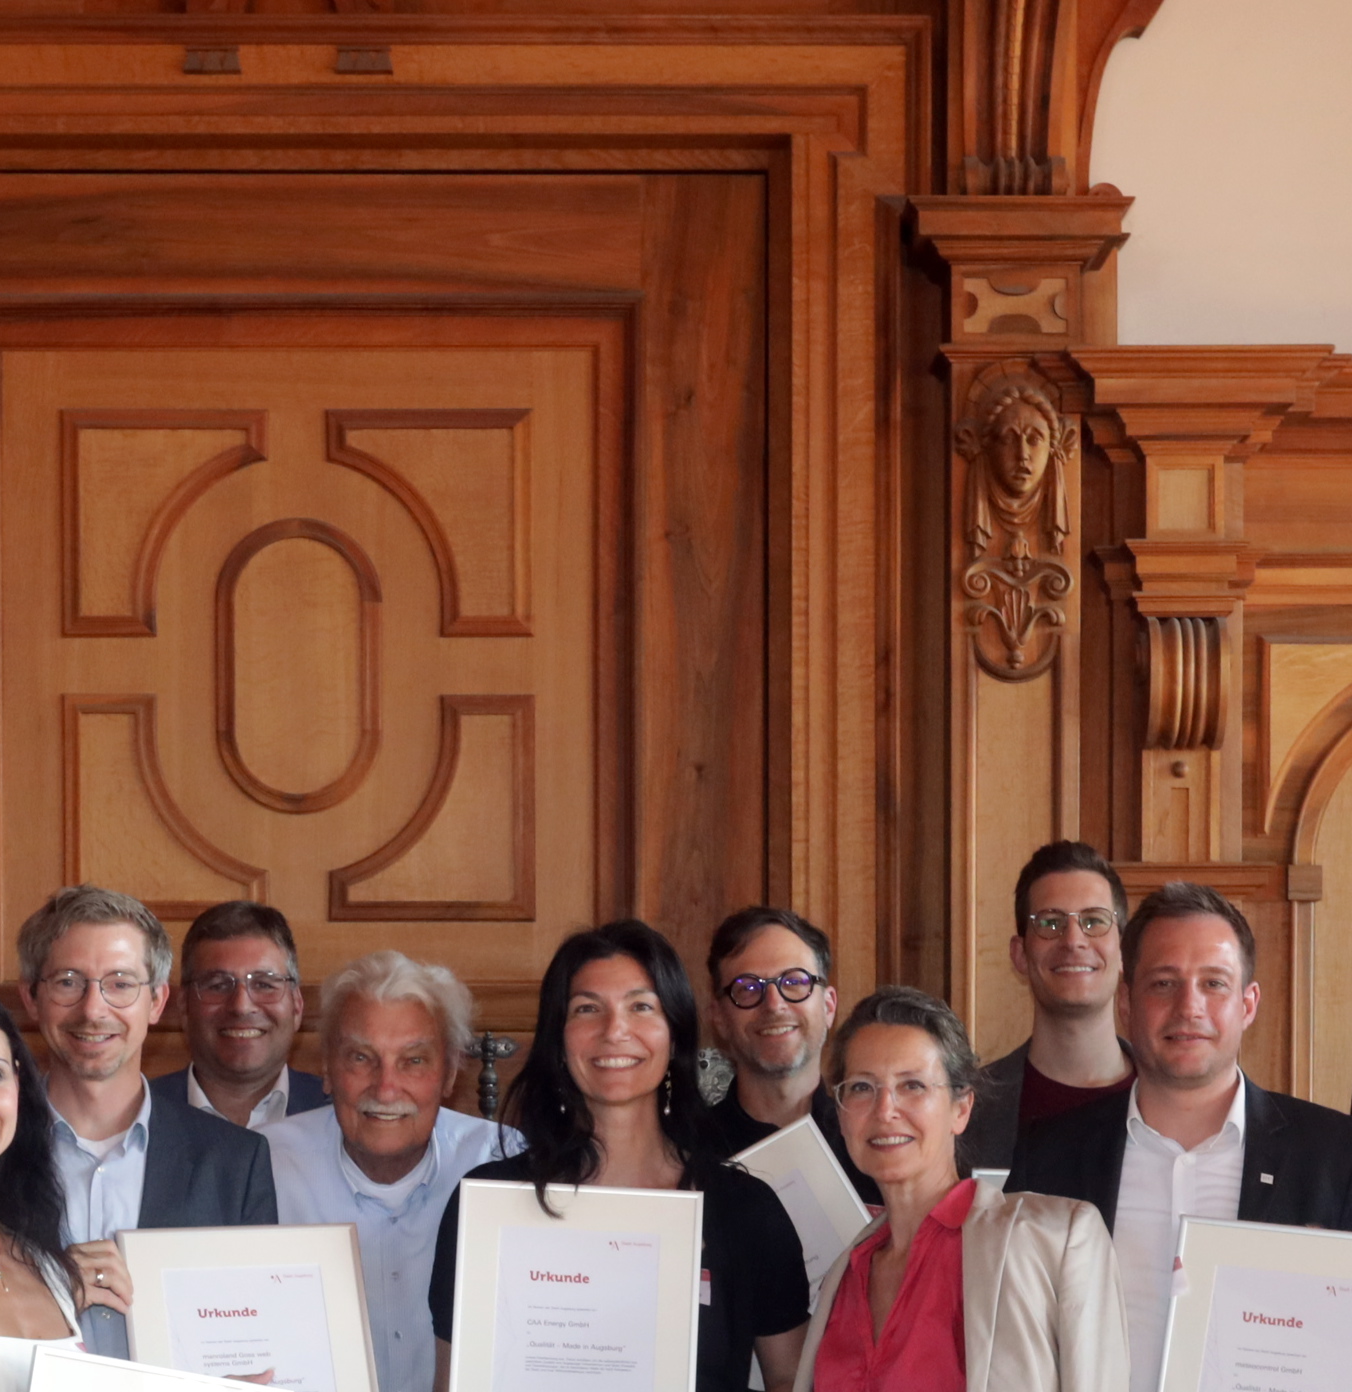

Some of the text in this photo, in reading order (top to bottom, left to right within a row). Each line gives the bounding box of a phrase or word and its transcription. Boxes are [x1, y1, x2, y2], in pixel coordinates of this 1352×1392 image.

[530, 1270, 590, 1283] Urkunde
[198, 1307, 258, 1318] Urkunde
[1243, 1311, 1303, 1328] Urkunde
